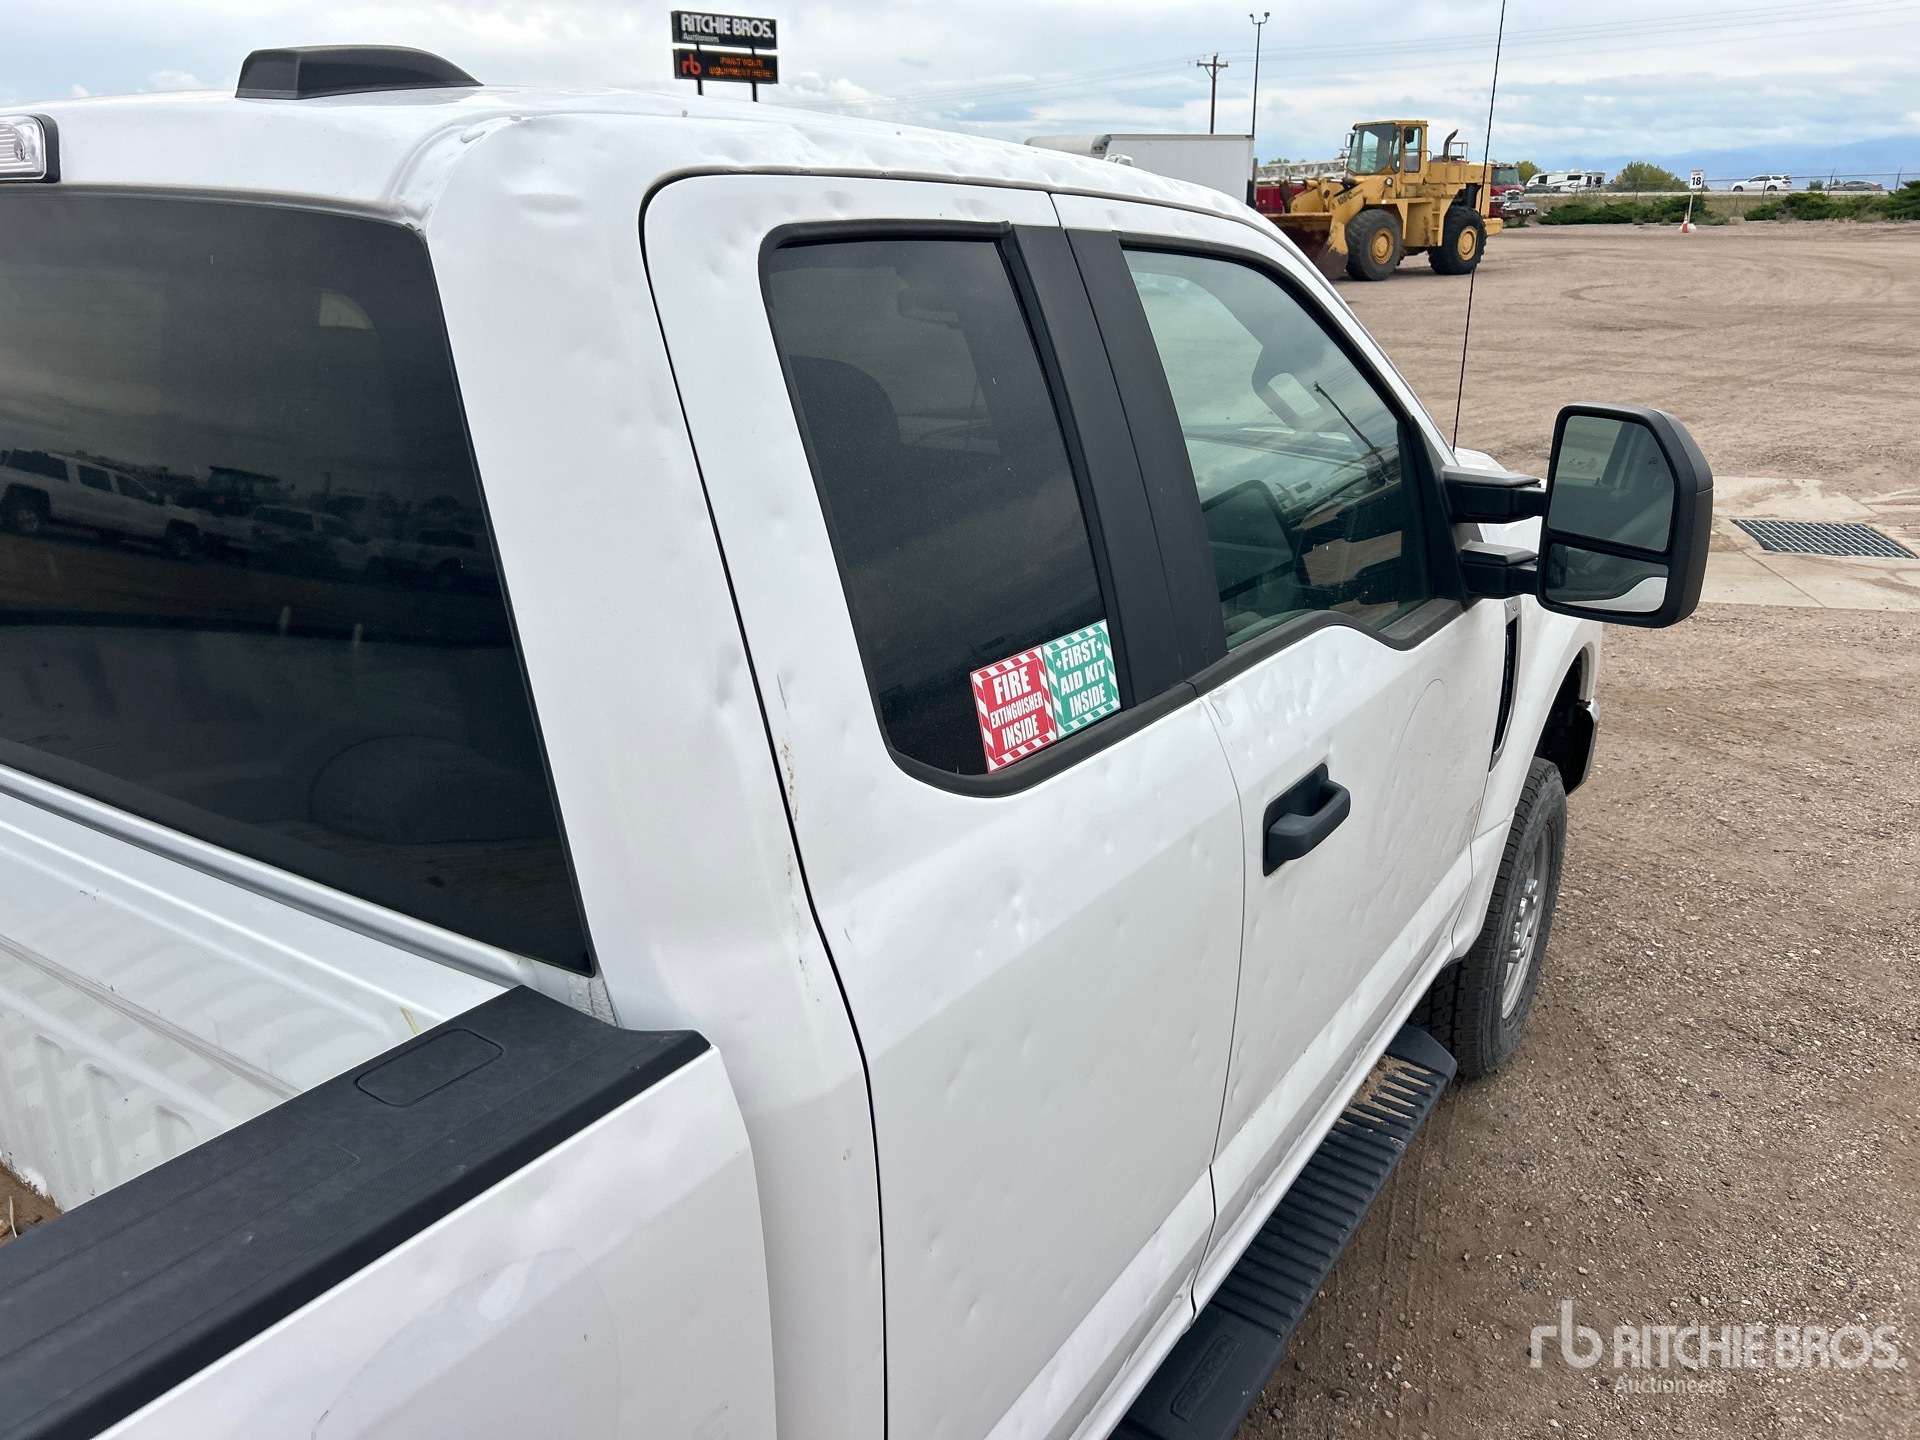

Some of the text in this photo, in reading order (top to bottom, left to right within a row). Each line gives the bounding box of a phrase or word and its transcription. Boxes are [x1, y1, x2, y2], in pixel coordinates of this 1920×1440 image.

[680, 14, 774, 38] RITCHIE BROS.
[681, 53, 702, 75] rb
[1692, 177, 1701, 185] 18
[1060, 638, 1098, 671] FIRST
[992, 666, 1032, 705] FIRE
[1060, 659, 1106, 696] AID KIT
[990, 691, 1044, 729] EXTINGUISHER
[1069, 683, 1107, 718] INSIDE
[1002, 716, 1040, 751] INSIDE
